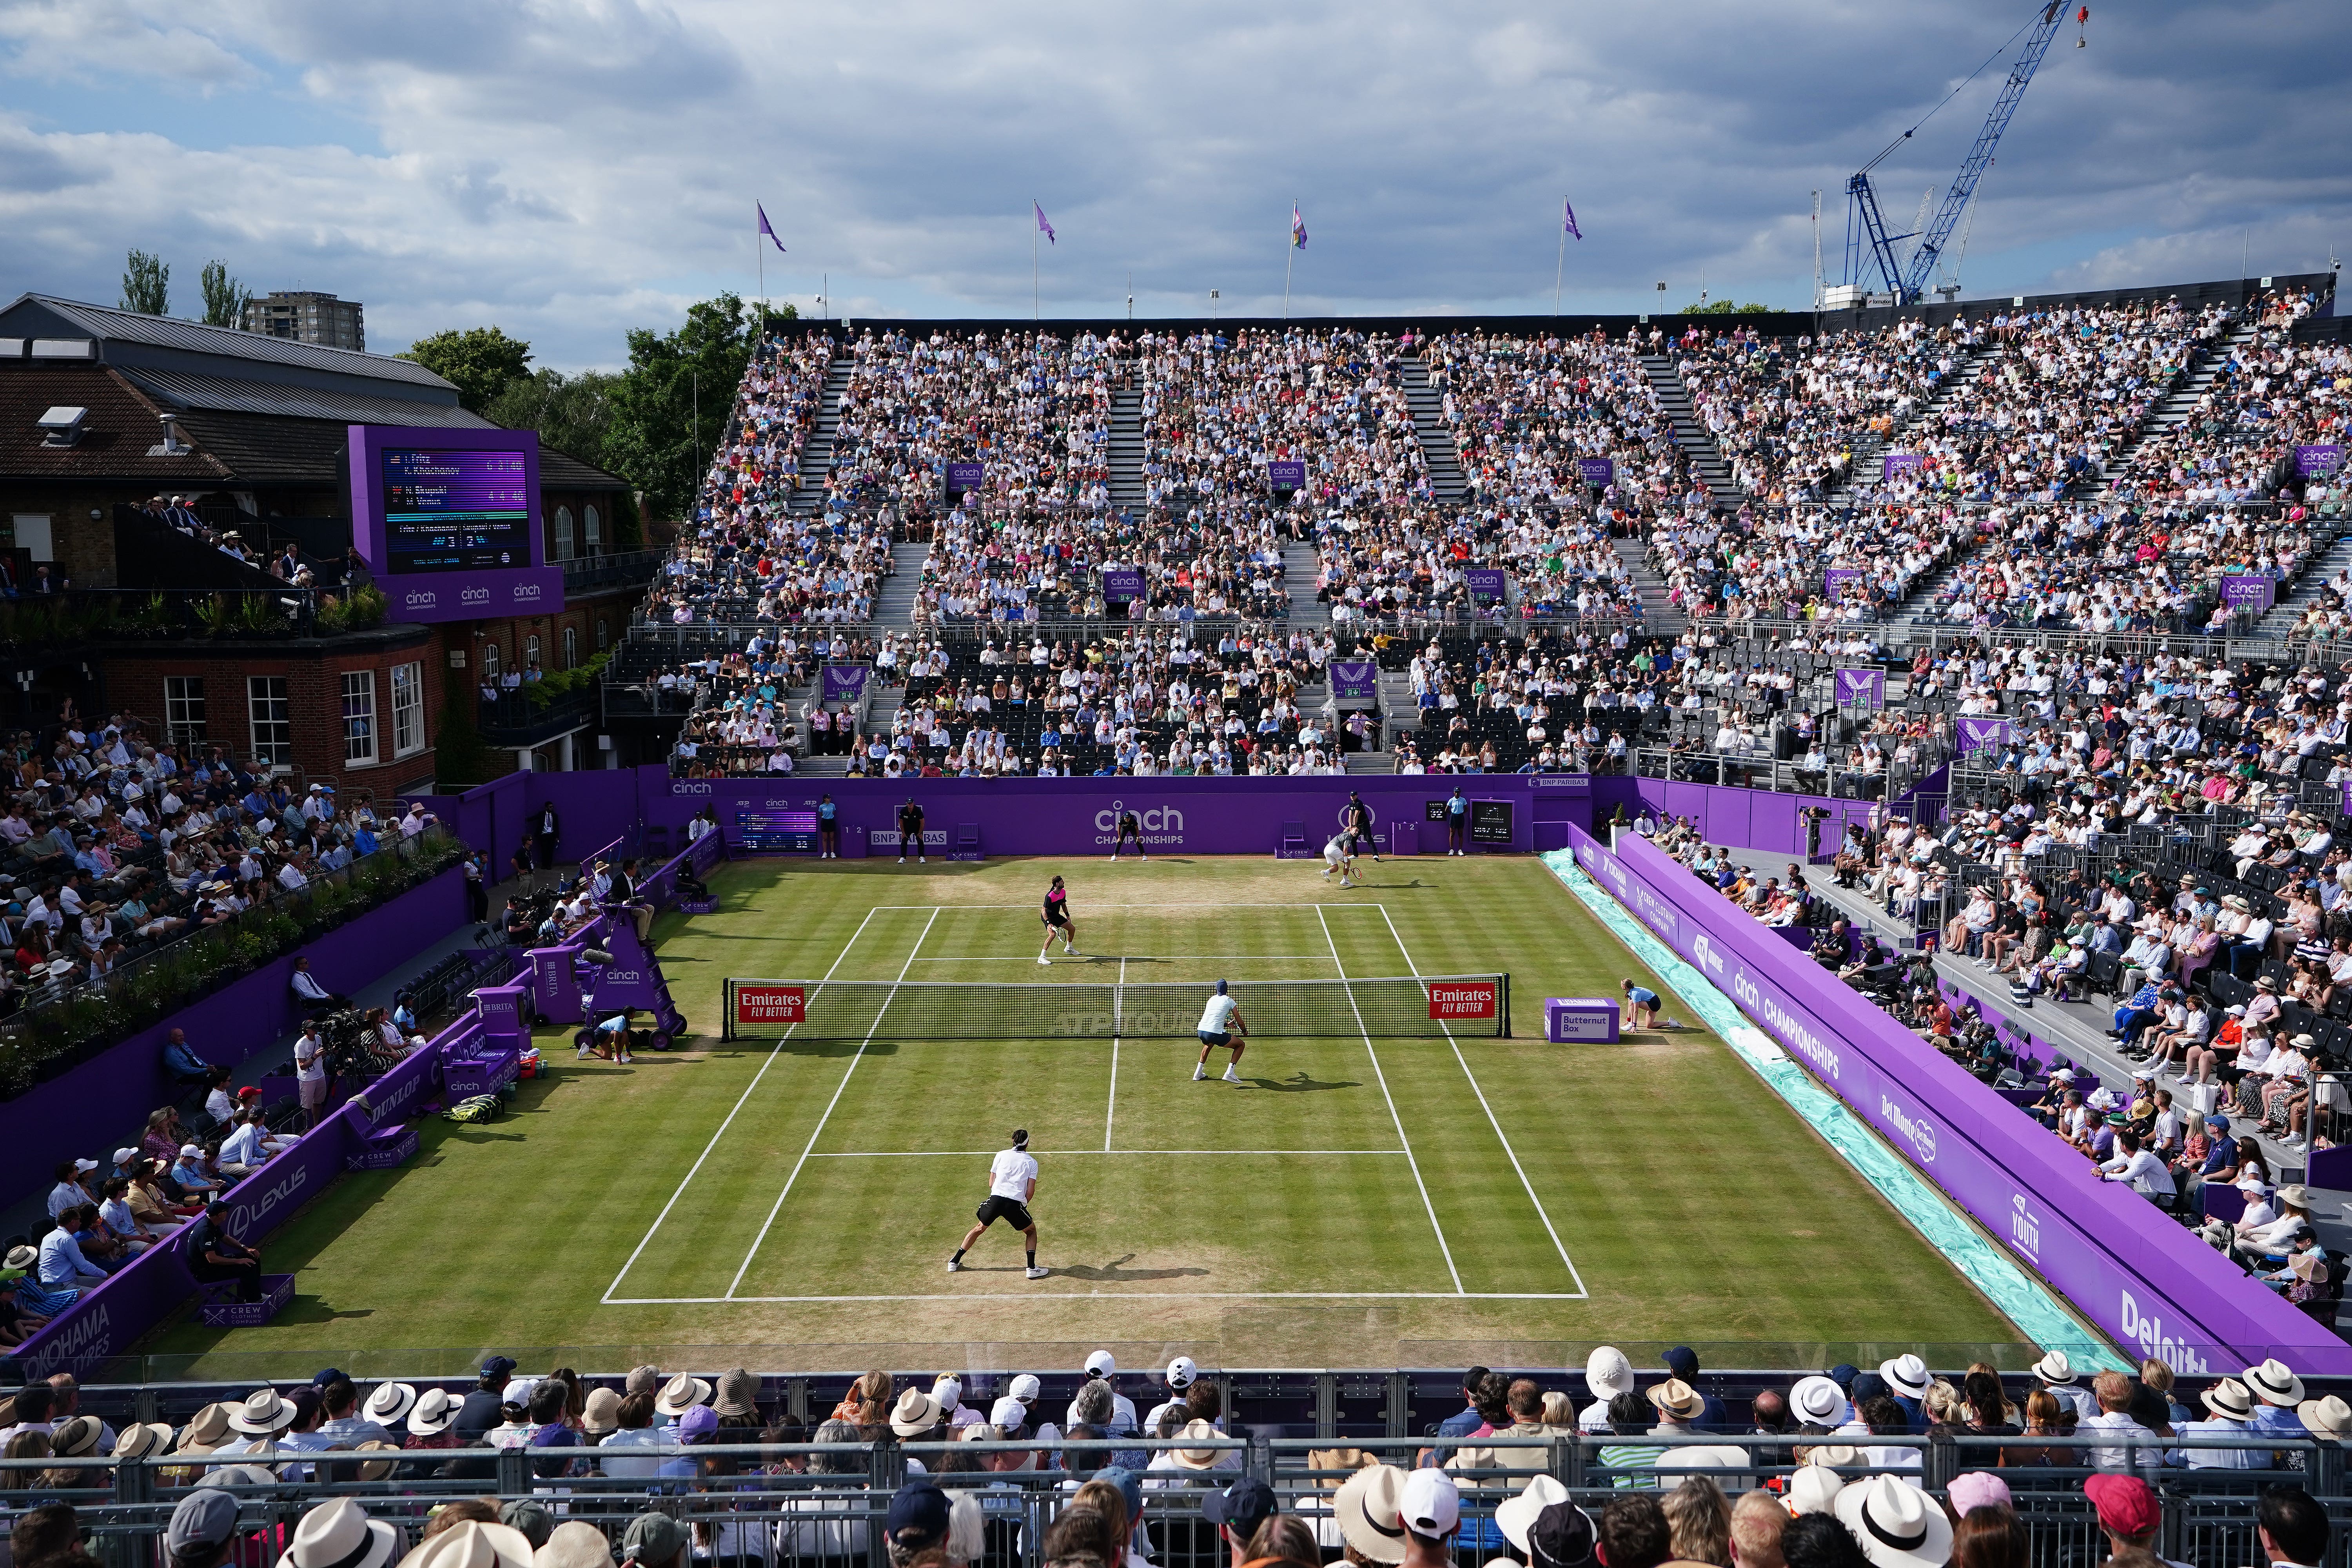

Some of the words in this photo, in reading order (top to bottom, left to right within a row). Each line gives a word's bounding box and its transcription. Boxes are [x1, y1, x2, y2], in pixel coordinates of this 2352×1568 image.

[414, 465, 459, 474] Khachanov
[955, 467, 979, 476] cinch
[1273, 465, 1298, 474] cinch
[1582, 463, 1606, 472] cinch
[415, 486, 447, 496] Skupski
[463, 523, 487, 533] Skupski
[448, 537, 455, 547] 3
[466, 536, 474, 546] 2
[1111, 575, 1138, 585] cinch
[1470, 574, 1497, 584] cinch
[461, 586, 489, 599] cinch
[514, 583, 540, 596] cinch
[406, 590, 436, 604] cinch
[673, 780, 711, 793] cinch
[766, 798, 788, 806] cinch
[873, 833, 895, 843] BNP
[1584, 840, 1594, 863] cinch
[1609, 860, 1626, 886] YOKOHAMA
[1618, 884, 1626, 898] TYRES
[1644, 892, 1655, 908] CREW
[1655, 902, 1675, 926] CLOTHING
[1650, 911, 1669, 935] COMPANY
[607, 968, 639, 979] cinch
[548, 971, 557, 997] BRITA
[742, 994, 801, 1005] Emirates
[1433, 989, 1492, 1002] Emirates
[751, 1007, 764, 1017] FLY
[766, 1007, 792, 1017] BETTER
[1442, 1003, 1454, 1013] FLY
[1456, 1002, 1483, 1013] BETTER
[1048, 1013, 1114, 1034] ATP
[1121, 1011, 1198, 1033] TOUR
[1563, 1016, 1606, 1024] Butternut
[1735, 966, 1759, 1011] cinch
[1764, 998, 1840, 1080] CHAMPIONSHIPS
[470, 1034, 486, 1056] cinch
[488, 1073, 503, 1093] cinch
[504, 1060, 517, 1080] cinch
[451, 1081, 479, 1090] cinch
[371, 1074, 420, 1124] DUNLOP
[1882, 1094, 1893, 1122] Del
[1893, 1104, 1915, 1142] Monte
[405, 1137, 415, 1147] CREW
[1923, 1132, 1935, 1151] Monte
[252, 1164, 306, 1221] LEXUS
[2012, 1210, 2038, 1254] YOUTH
[278, 1282, 290, 1297] CREW
[22, 1303, 110, 1385] OKOHAMA
[72, 1333, 110, 1378] TYRES
